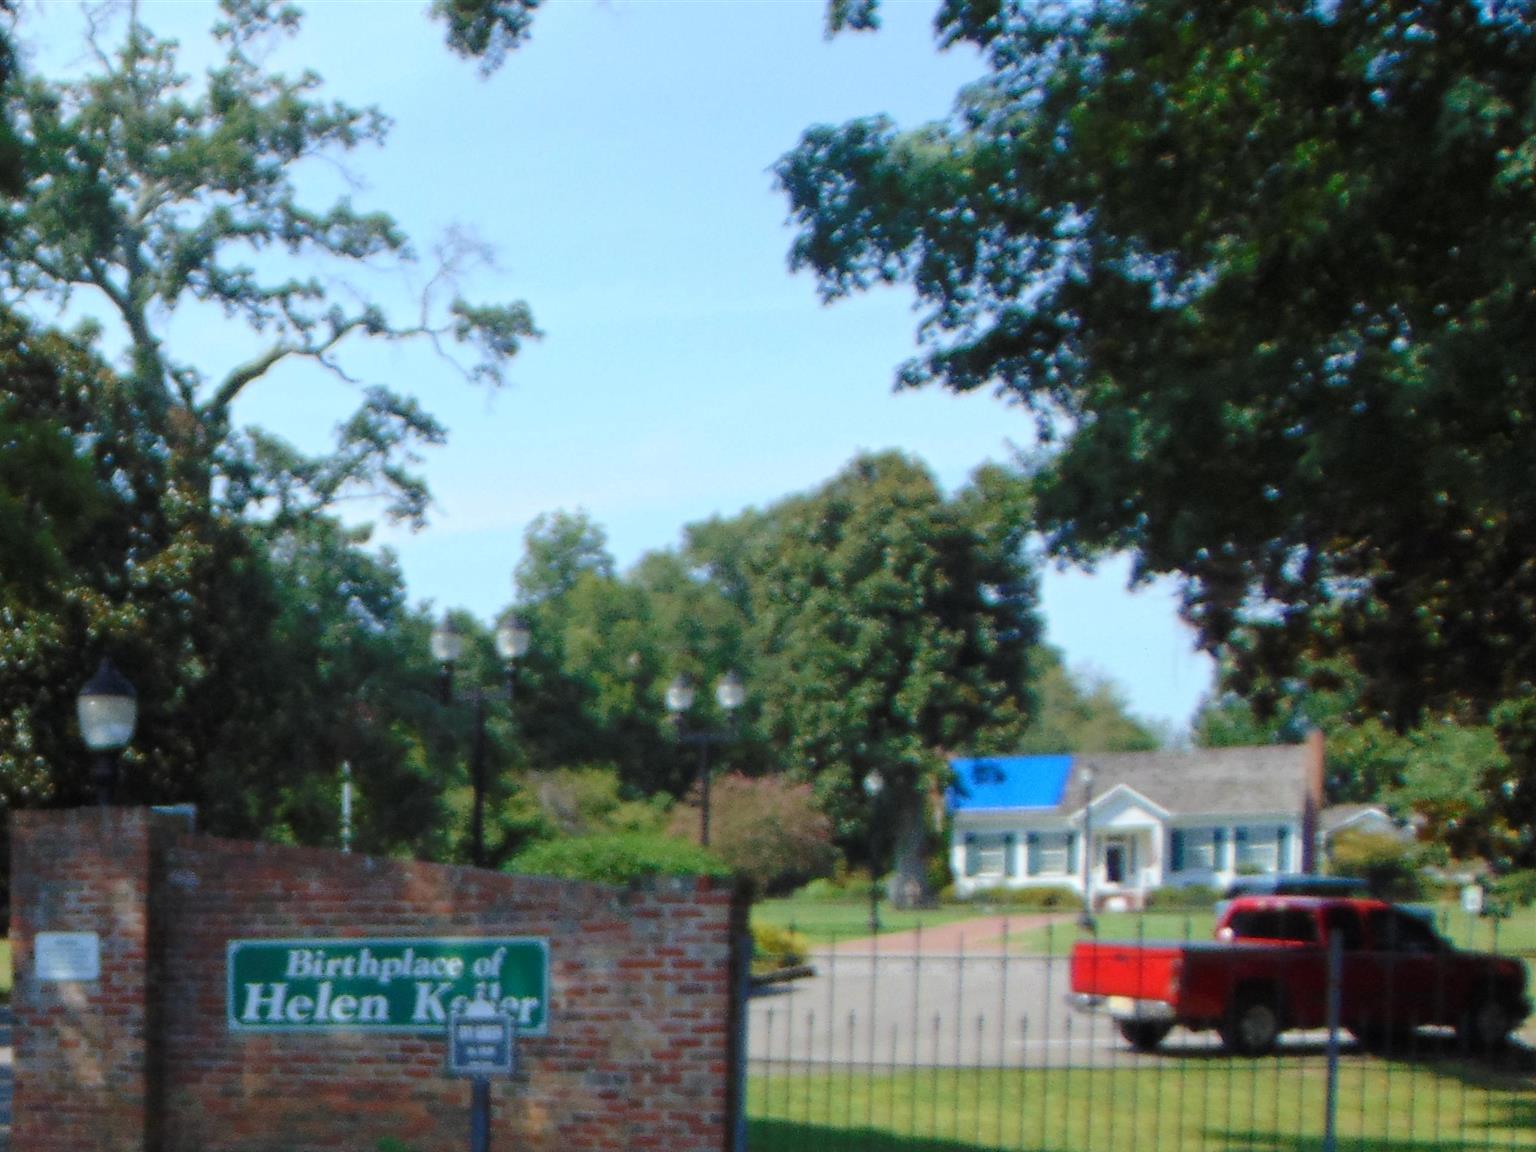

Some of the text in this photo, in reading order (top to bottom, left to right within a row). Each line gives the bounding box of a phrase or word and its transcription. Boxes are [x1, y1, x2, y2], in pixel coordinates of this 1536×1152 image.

[286, 947, 507, 983] Birthplace of
[242, 982, 389, 1023] Helen
